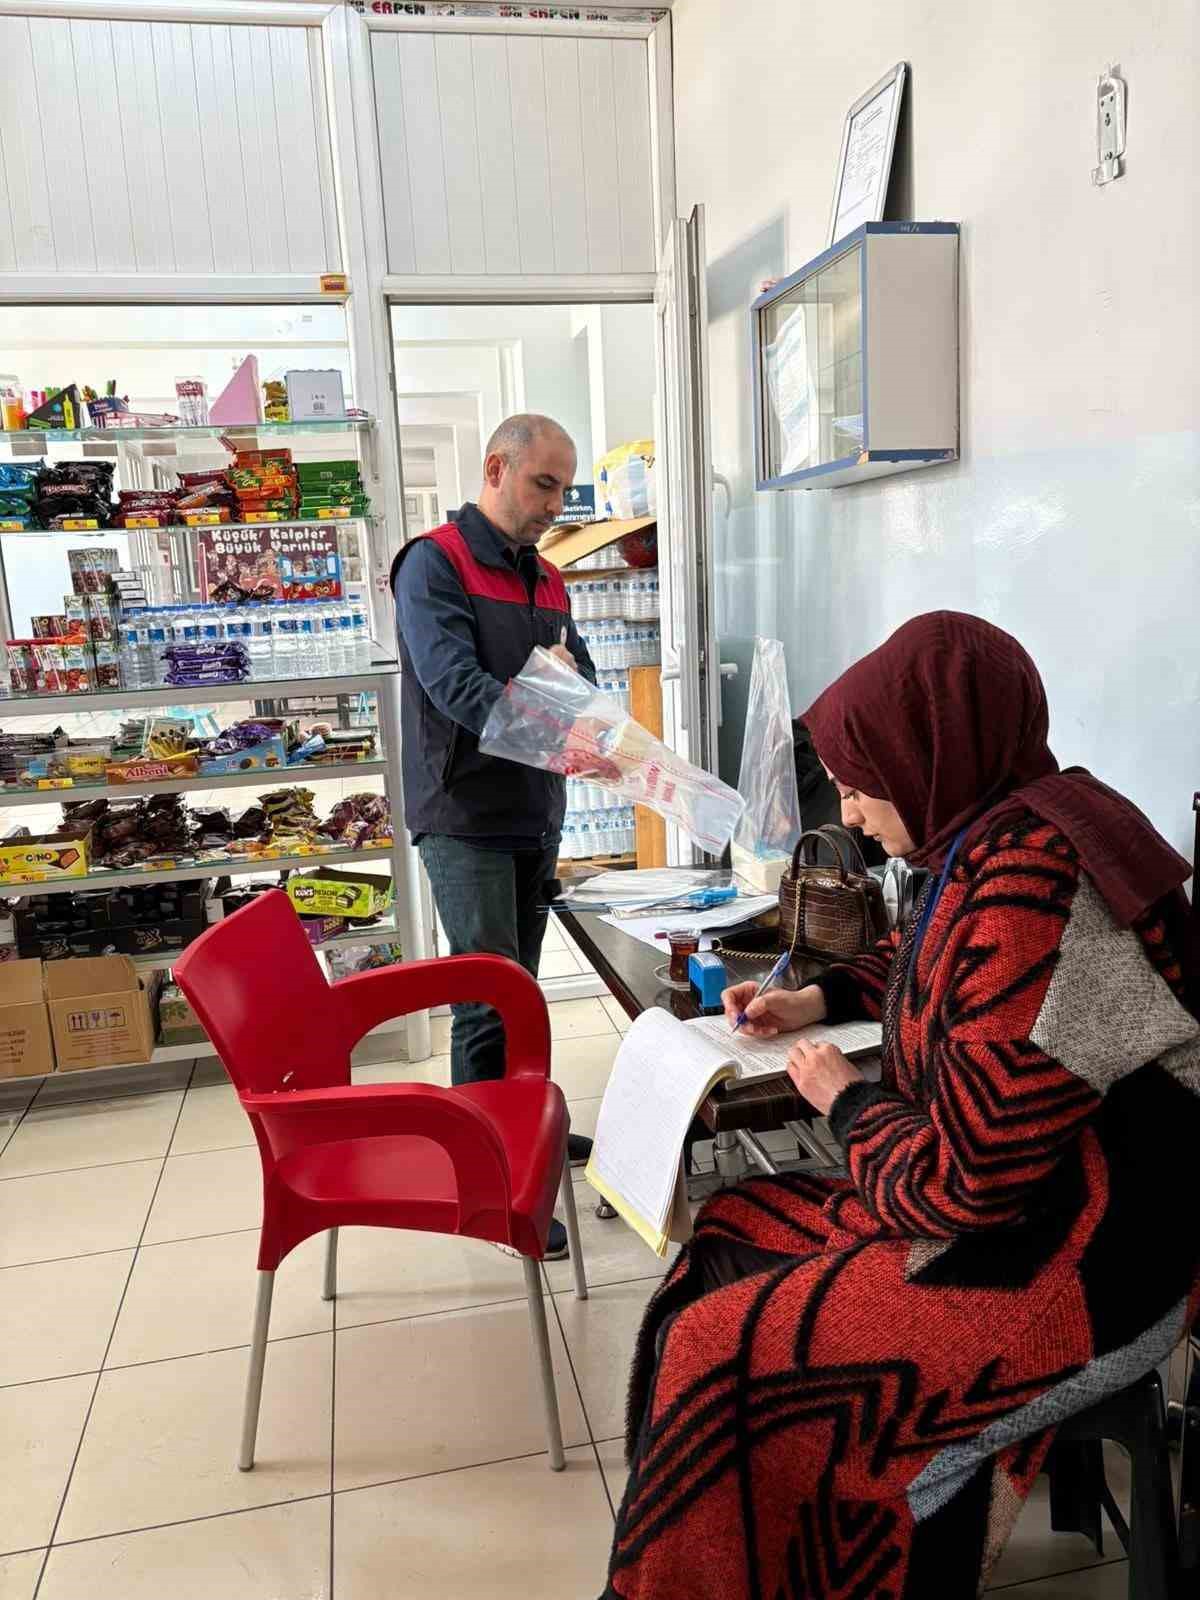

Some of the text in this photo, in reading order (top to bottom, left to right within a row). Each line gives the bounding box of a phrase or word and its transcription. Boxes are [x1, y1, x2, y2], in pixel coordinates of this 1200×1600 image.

[371, 1, 426, 15] ERPEN
[211, 528, 327, 543] Küçük Kalpler
[215, 540, 333, 554] Büyük Yarınlar
